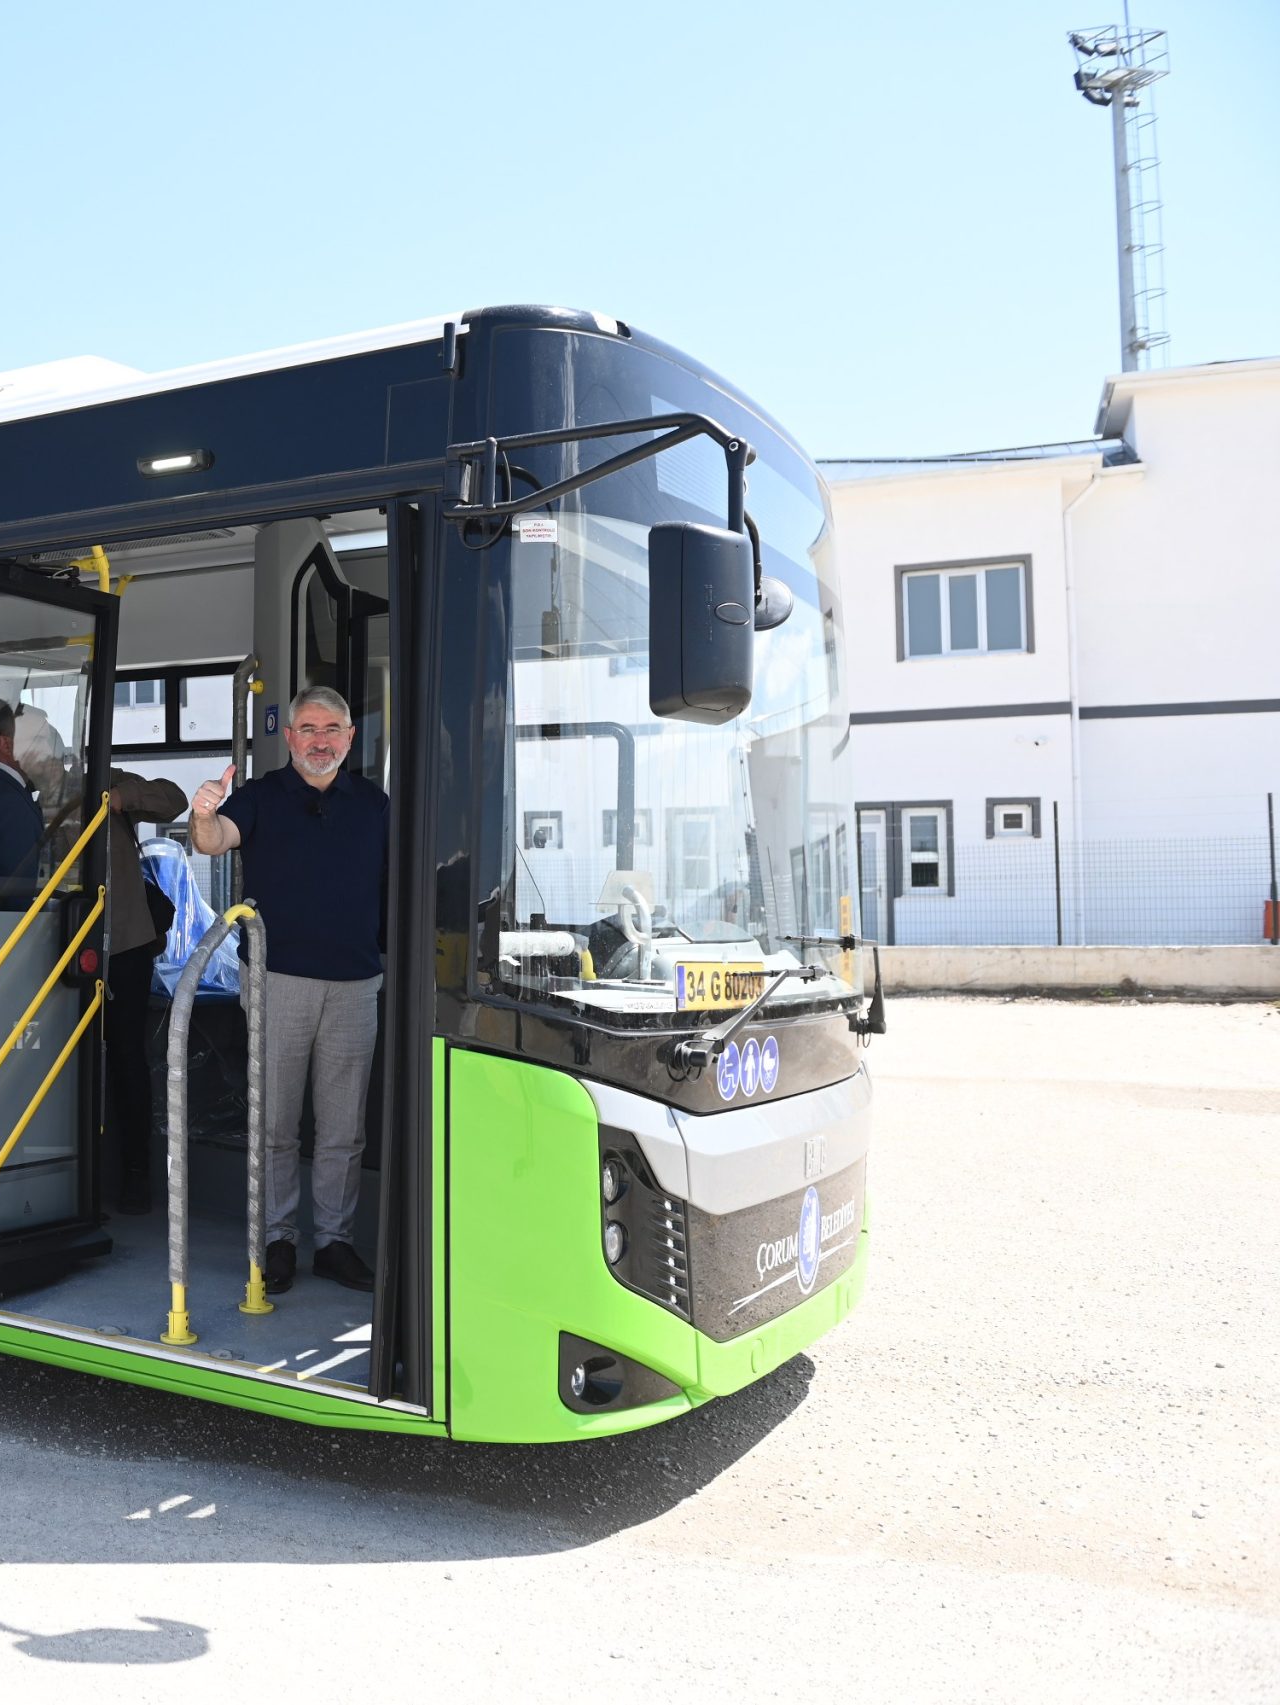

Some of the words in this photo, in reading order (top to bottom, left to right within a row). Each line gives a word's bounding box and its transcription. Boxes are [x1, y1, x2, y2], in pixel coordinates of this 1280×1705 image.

[686, 971, 706, 1002] 34
[710, 971, 721, 1001] G
[756, 1231, 799, 1282] ÇORUM
